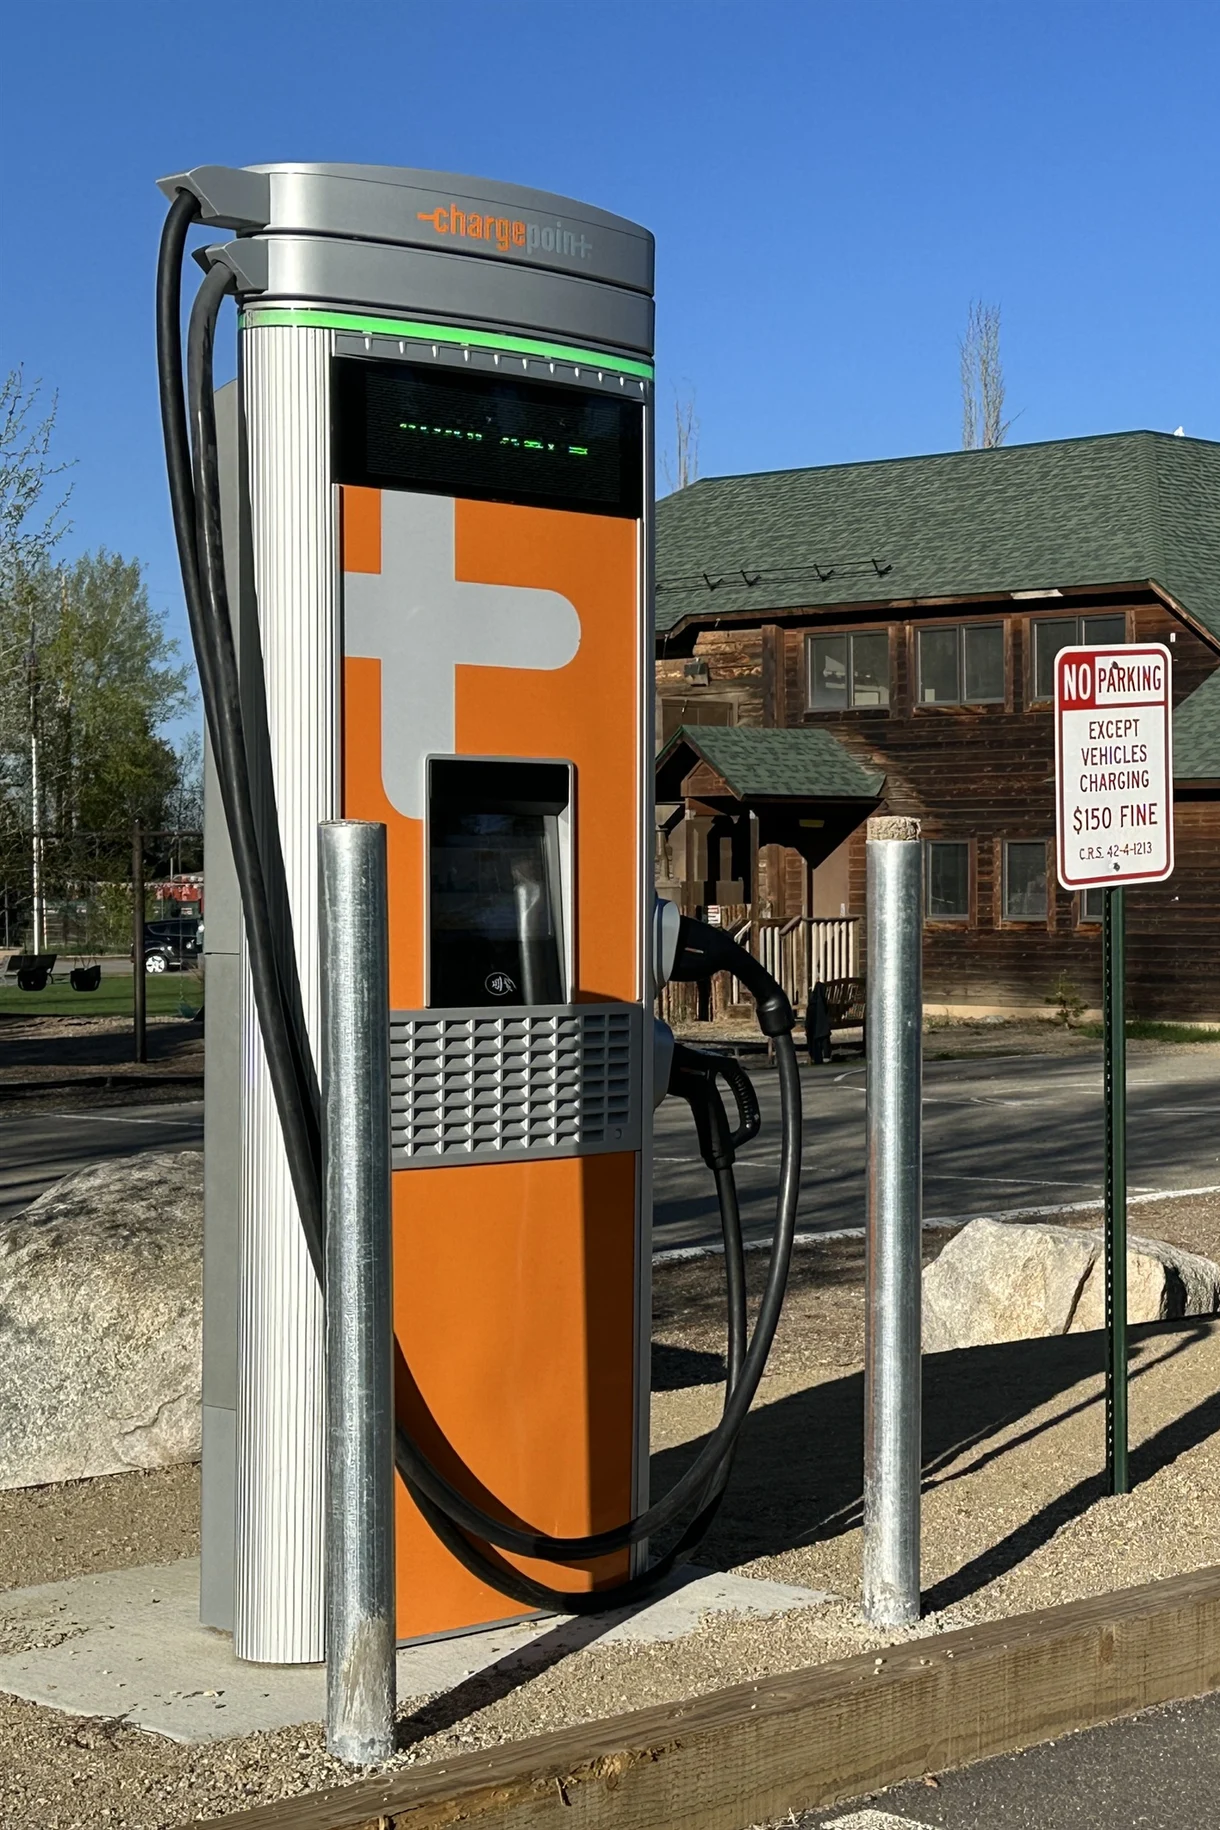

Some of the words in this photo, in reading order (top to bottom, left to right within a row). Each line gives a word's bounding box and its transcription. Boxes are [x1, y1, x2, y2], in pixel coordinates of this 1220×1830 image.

[1063, 663, 1092, 701] NO
[1098, 665, 1162, 693] PARKING
[1089, 718, 1140, 740] EXCEPT
[1081, 744, 1147, 766] VEHICLES
[1080, 770, 1149, 793] CHARGING
[1073, 805, 1112, 835] $150
[1120, 803, 1158, 828] FINE
[1107, 841, 1152, 858] 42-4-1213
